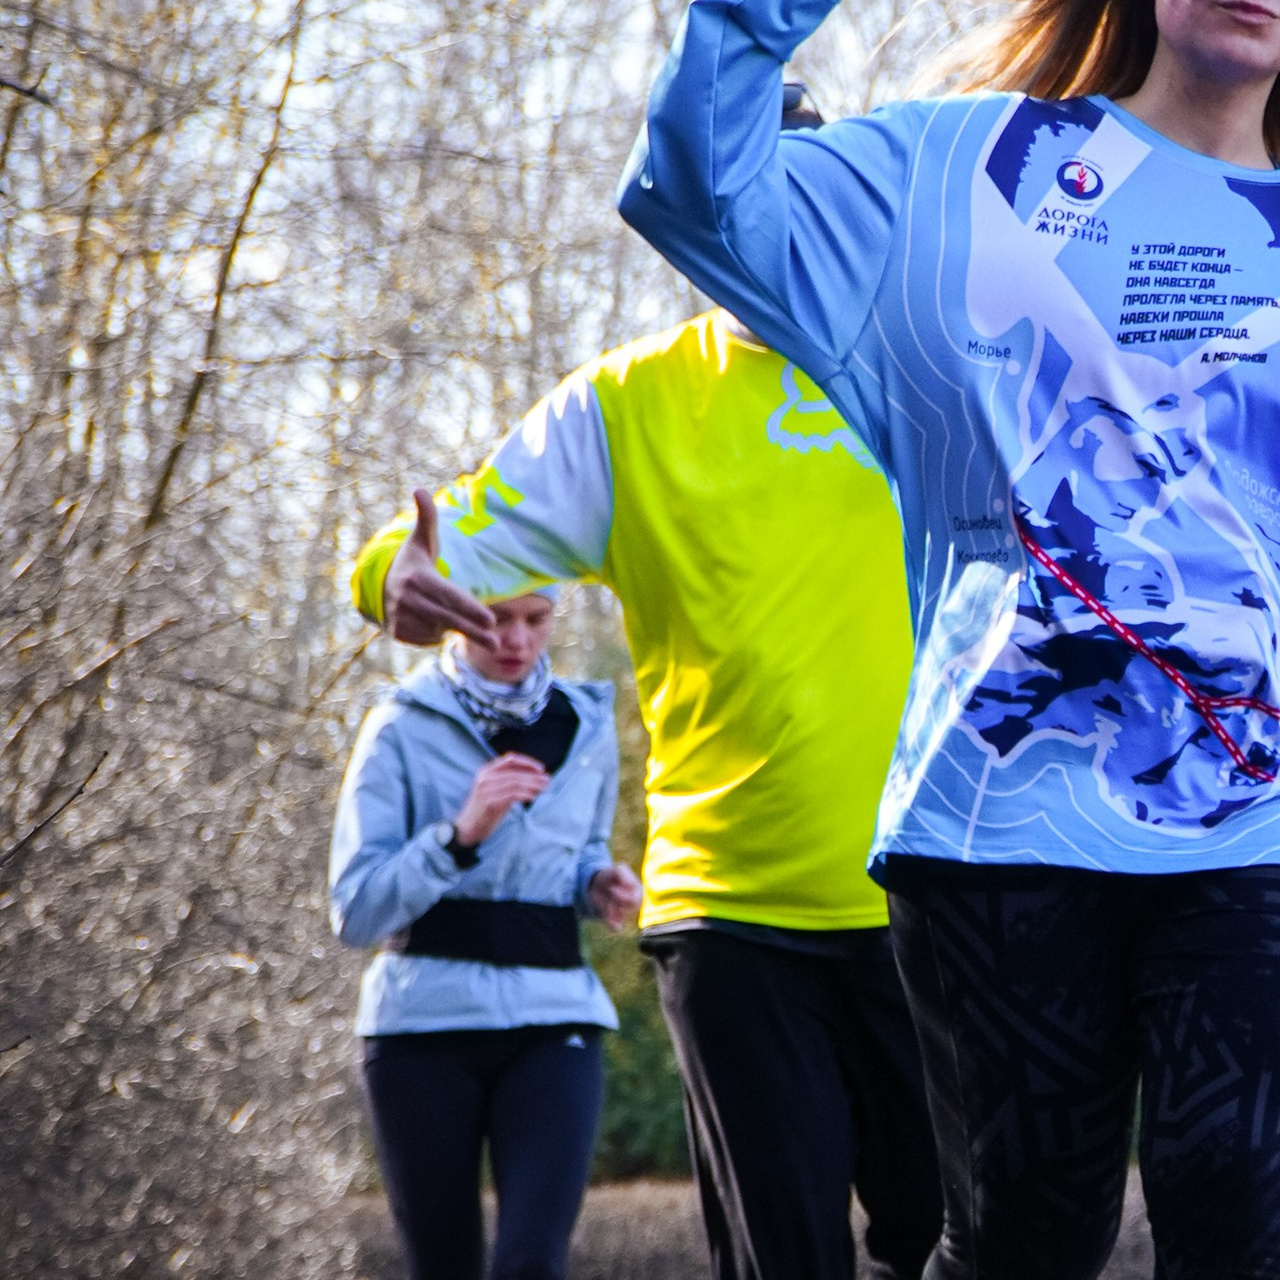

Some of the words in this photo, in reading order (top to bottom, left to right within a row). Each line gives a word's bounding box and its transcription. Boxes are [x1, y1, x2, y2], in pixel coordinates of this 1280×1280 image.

[1038, 207, 1108, 231] ДОРОГА
[1035, 220, 1108, 245] ЖИЗНИ
[1131, 245, 1140, 255] У
[1143, 242, 1176, 255] ЭТОЙ
[1178, 245, 1226, 258] ДОРОГИ
[1129, 260, 1145, 271] НЕ
[1148, 260, 1188, 272] БУДЕТ
[1191, 262, 1231, 274] КОНЦА
[1125, 277, 1151, 288] ОНА
[1154, 277, 1215, 290] НАВСЕГДА
[1123, 294, 1186, 307] ПРОЛЕГЛА
[1189, 294, 1227, 306] ЧЕРЕЗ
[1230, 295, 1280, 309] ПАМЯТЬ,
[1119, 311, 1169, 326] НАВЕКИ
[1172, 311, 1224, 322] ПРОШЛА
[1117, 330, 1157, 345] ЧЕРЕЗ
[1159, 327, 1197, 342] НАШИ
[1200, 327, 1250, 340] СЕРДЦА.
[967, 340, 1011, 359] Морье
[1213, 352, 1267, 364] МОЛЧАНОВ
